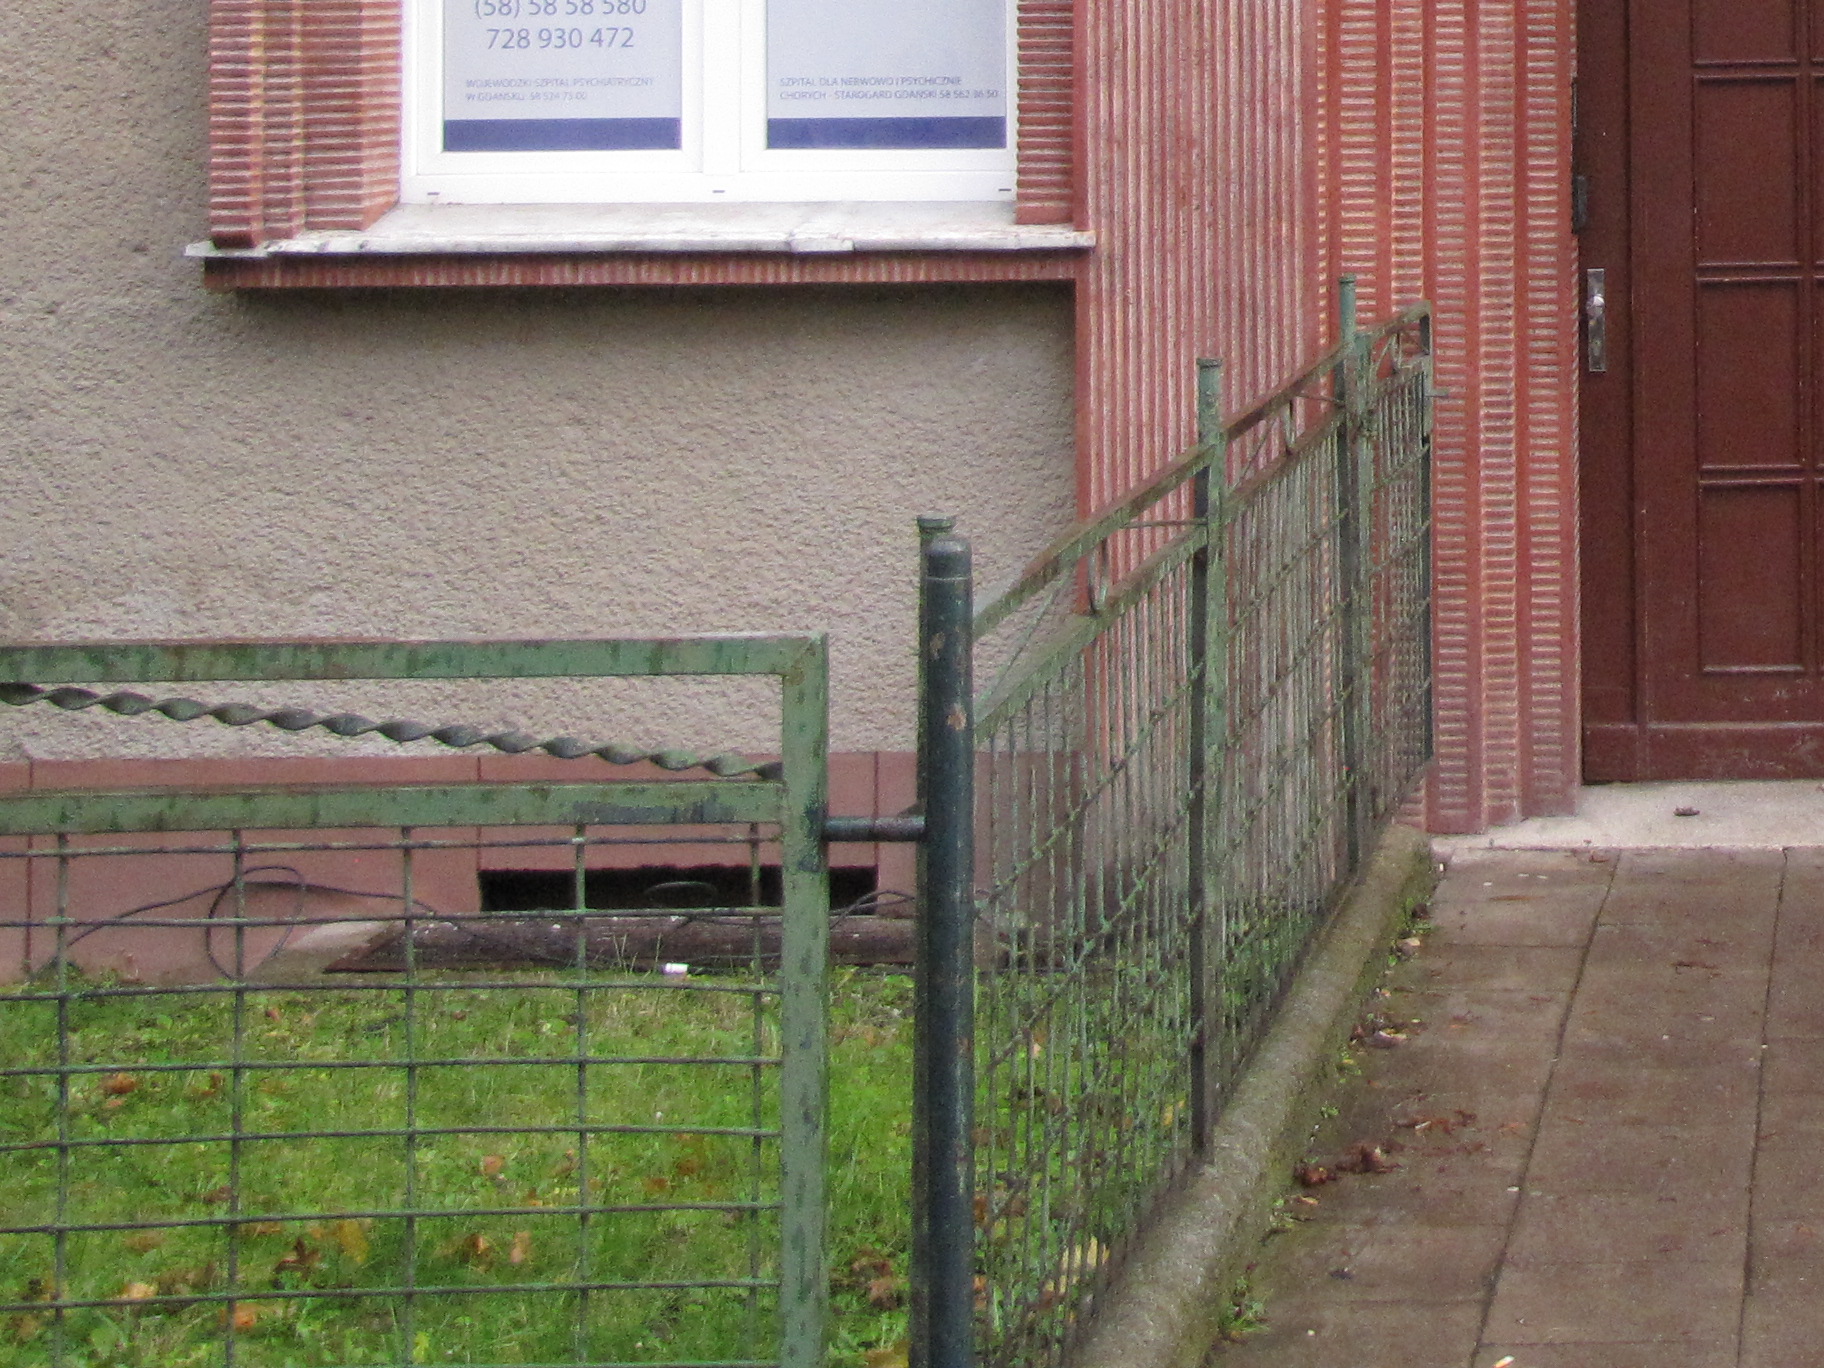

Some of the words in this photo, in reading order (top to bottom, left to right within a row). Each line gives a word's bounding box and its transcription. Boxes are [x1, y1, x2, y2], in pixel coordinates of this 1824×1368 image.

[486, 28, 530, 50] 728
[538, 28, 583, 49] 930
[590, 27, 634, 48] 472
[780, 77, 816, 86] SZPITAL
[819, 77, 838, 86] DLA
